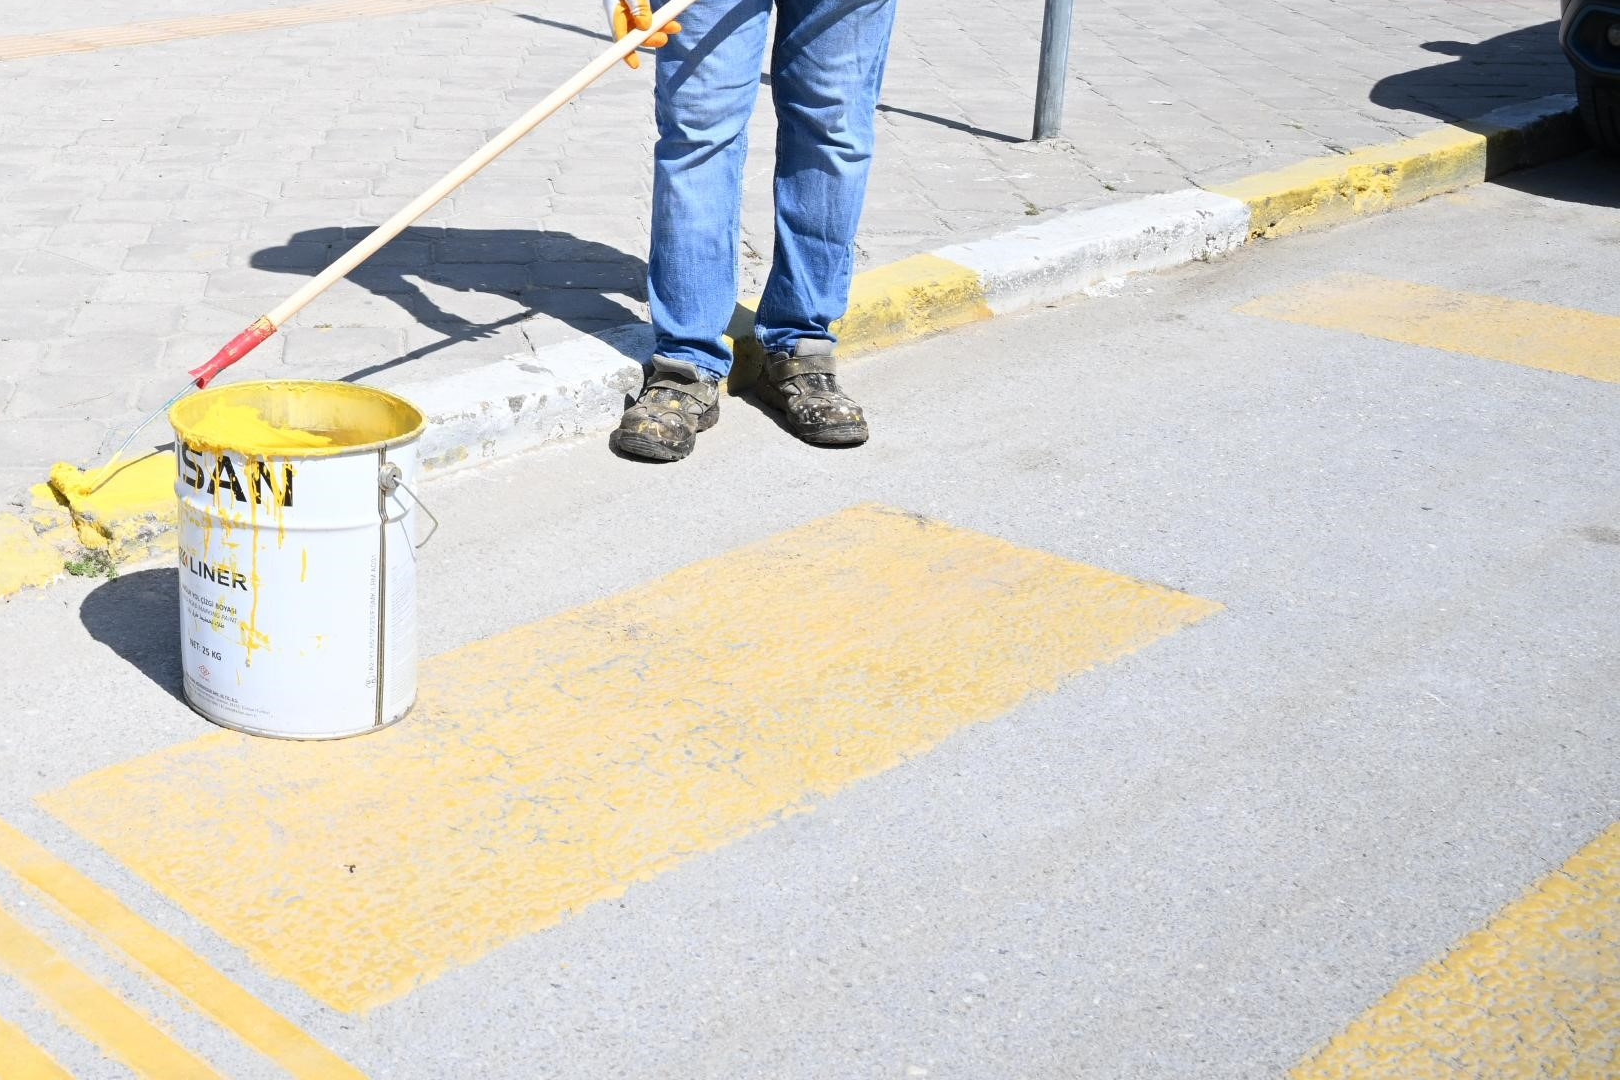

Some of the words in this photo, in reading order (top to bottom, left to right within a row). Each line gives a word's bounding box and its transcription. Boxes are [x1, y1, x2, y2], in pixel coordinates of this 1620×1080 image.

[189, 555, 248, 592] LINER
[202, 645, 210, 657] 25
[211, 650, 222, 661] KG
